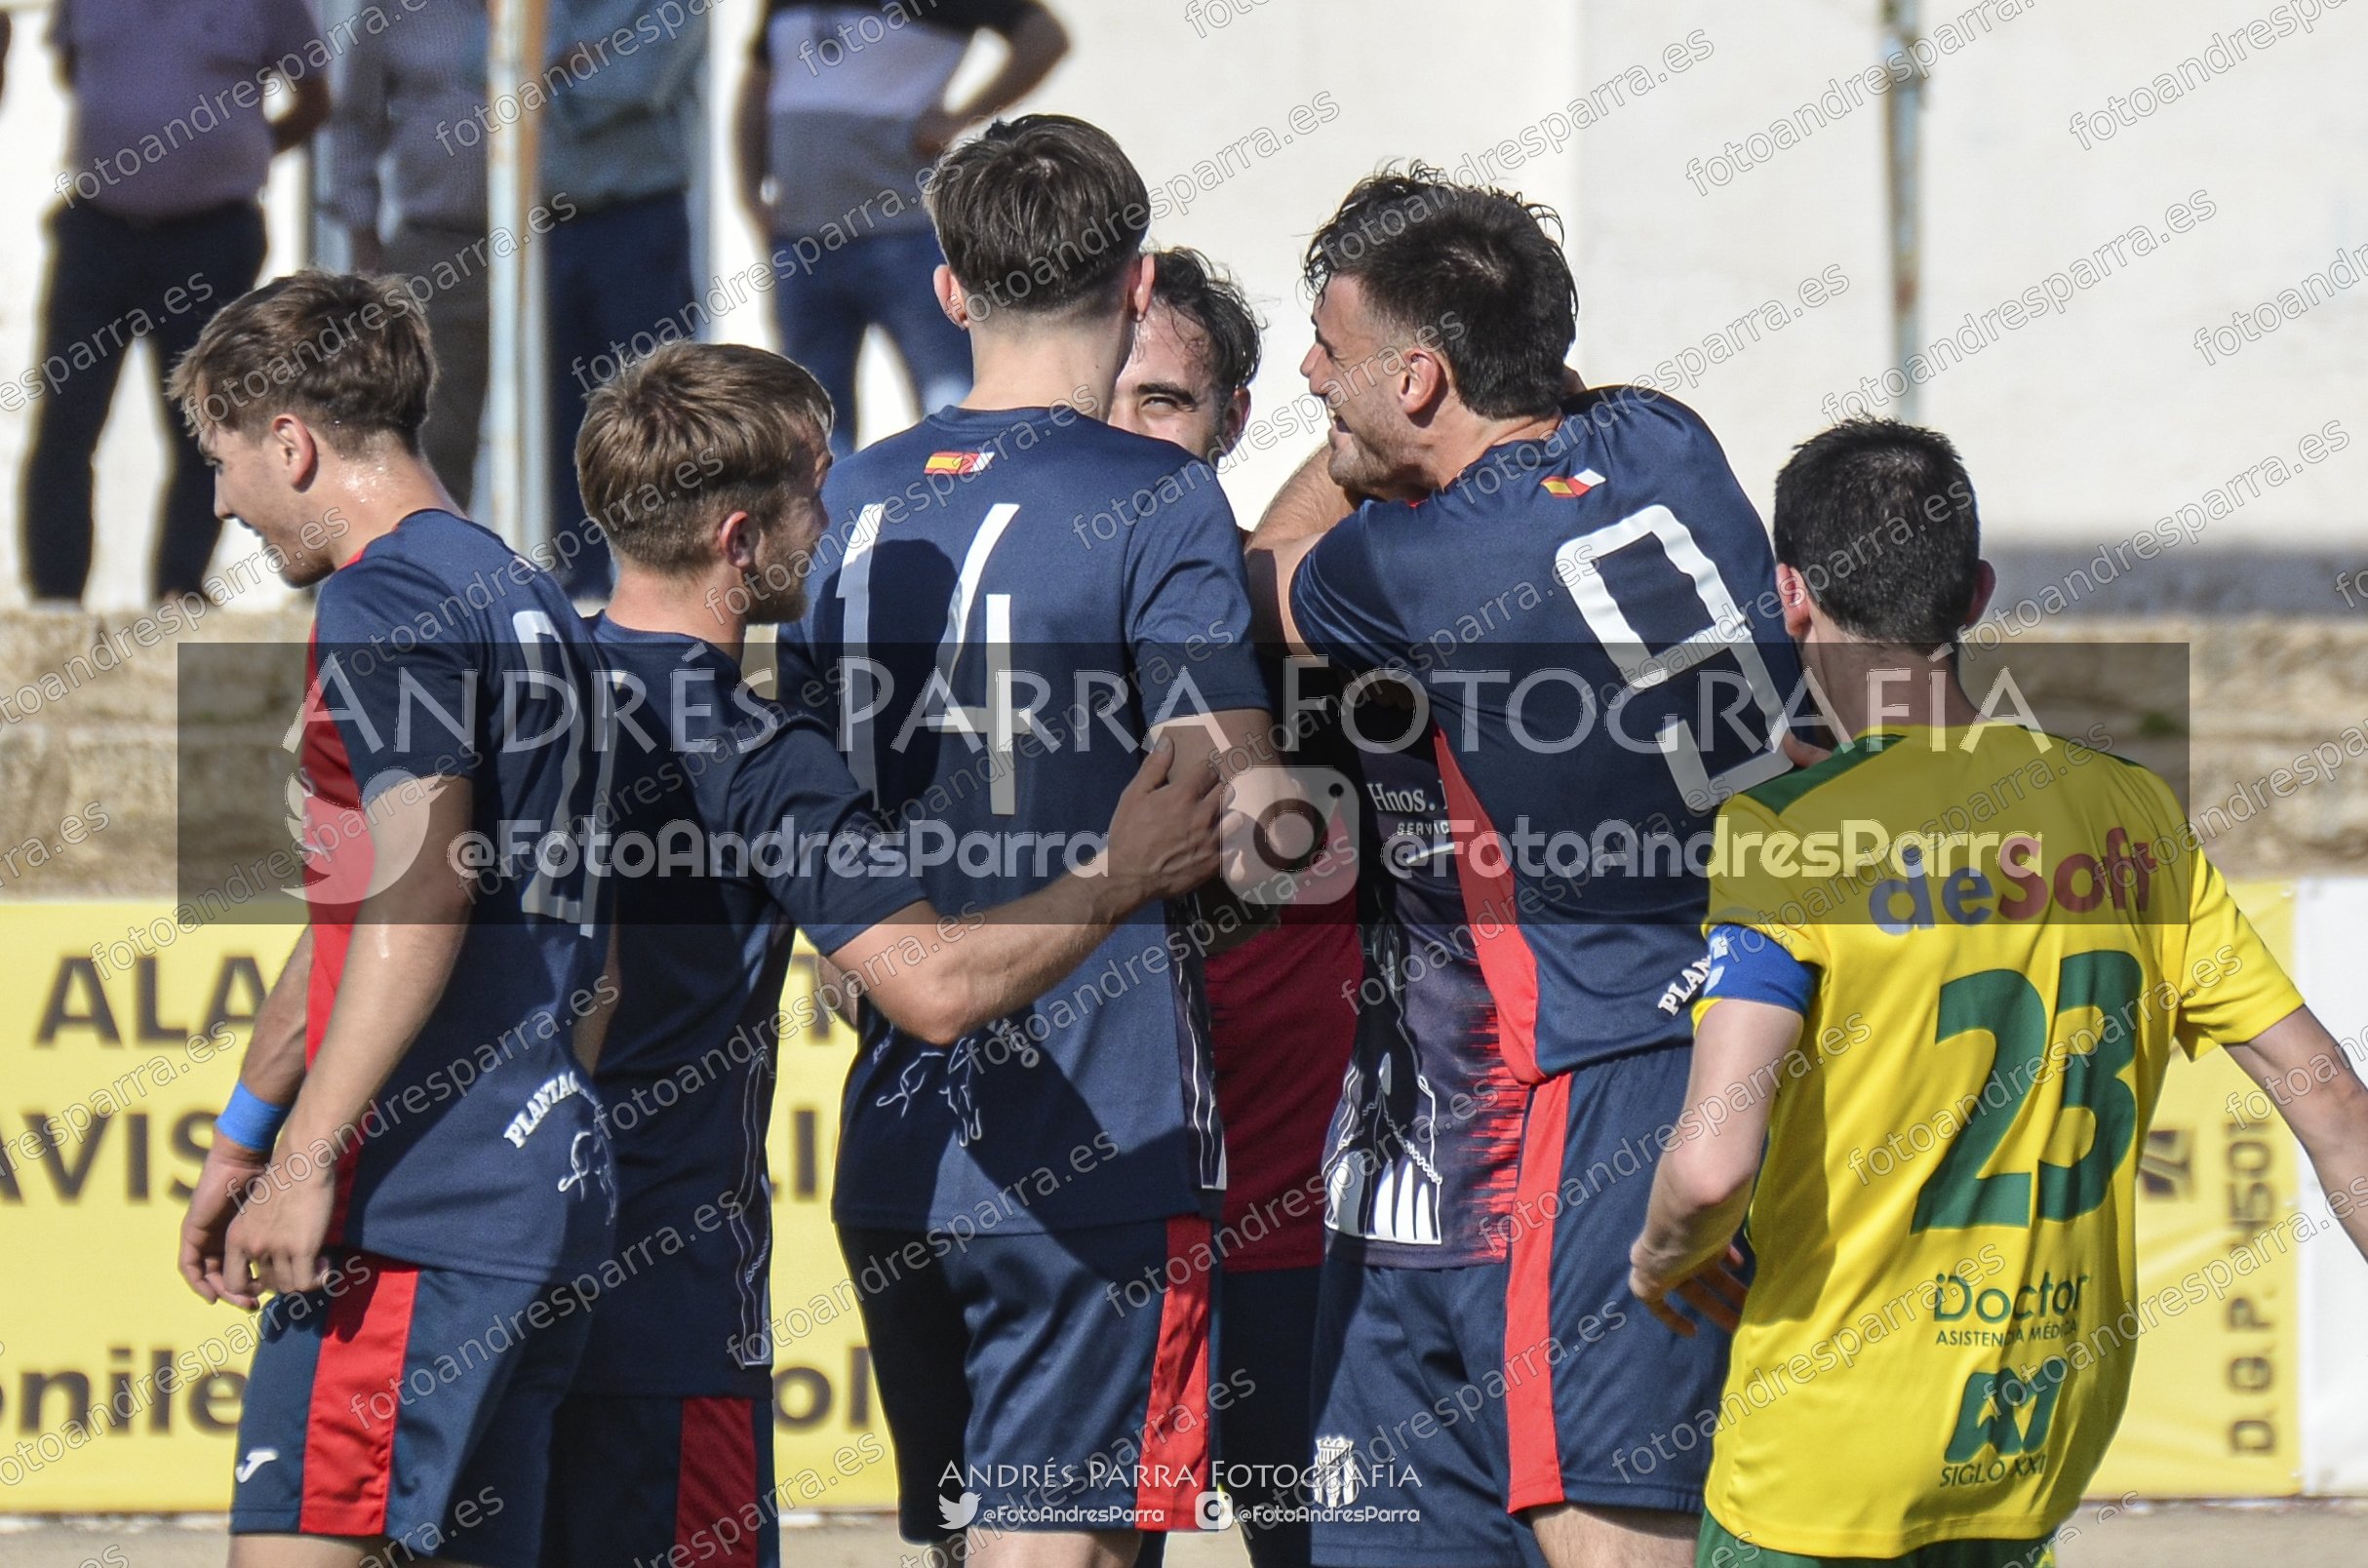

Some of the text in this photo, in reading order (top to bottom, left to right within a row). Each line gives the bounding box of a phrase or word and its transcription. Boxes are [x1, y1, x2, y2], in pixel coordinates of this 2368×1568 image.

[836, 503, 1031, 814] 14
[1366, 783, 1437, 812] Hnos.
[1869, 826, 2157, 936] deSoft
[1910, 949, 2145, 1235] 23
[0, 1109, 220, 1204] VIS
[0, 1346, 251, 1436] nile
[1939, 1459, 2006, 1488] SIGLO
